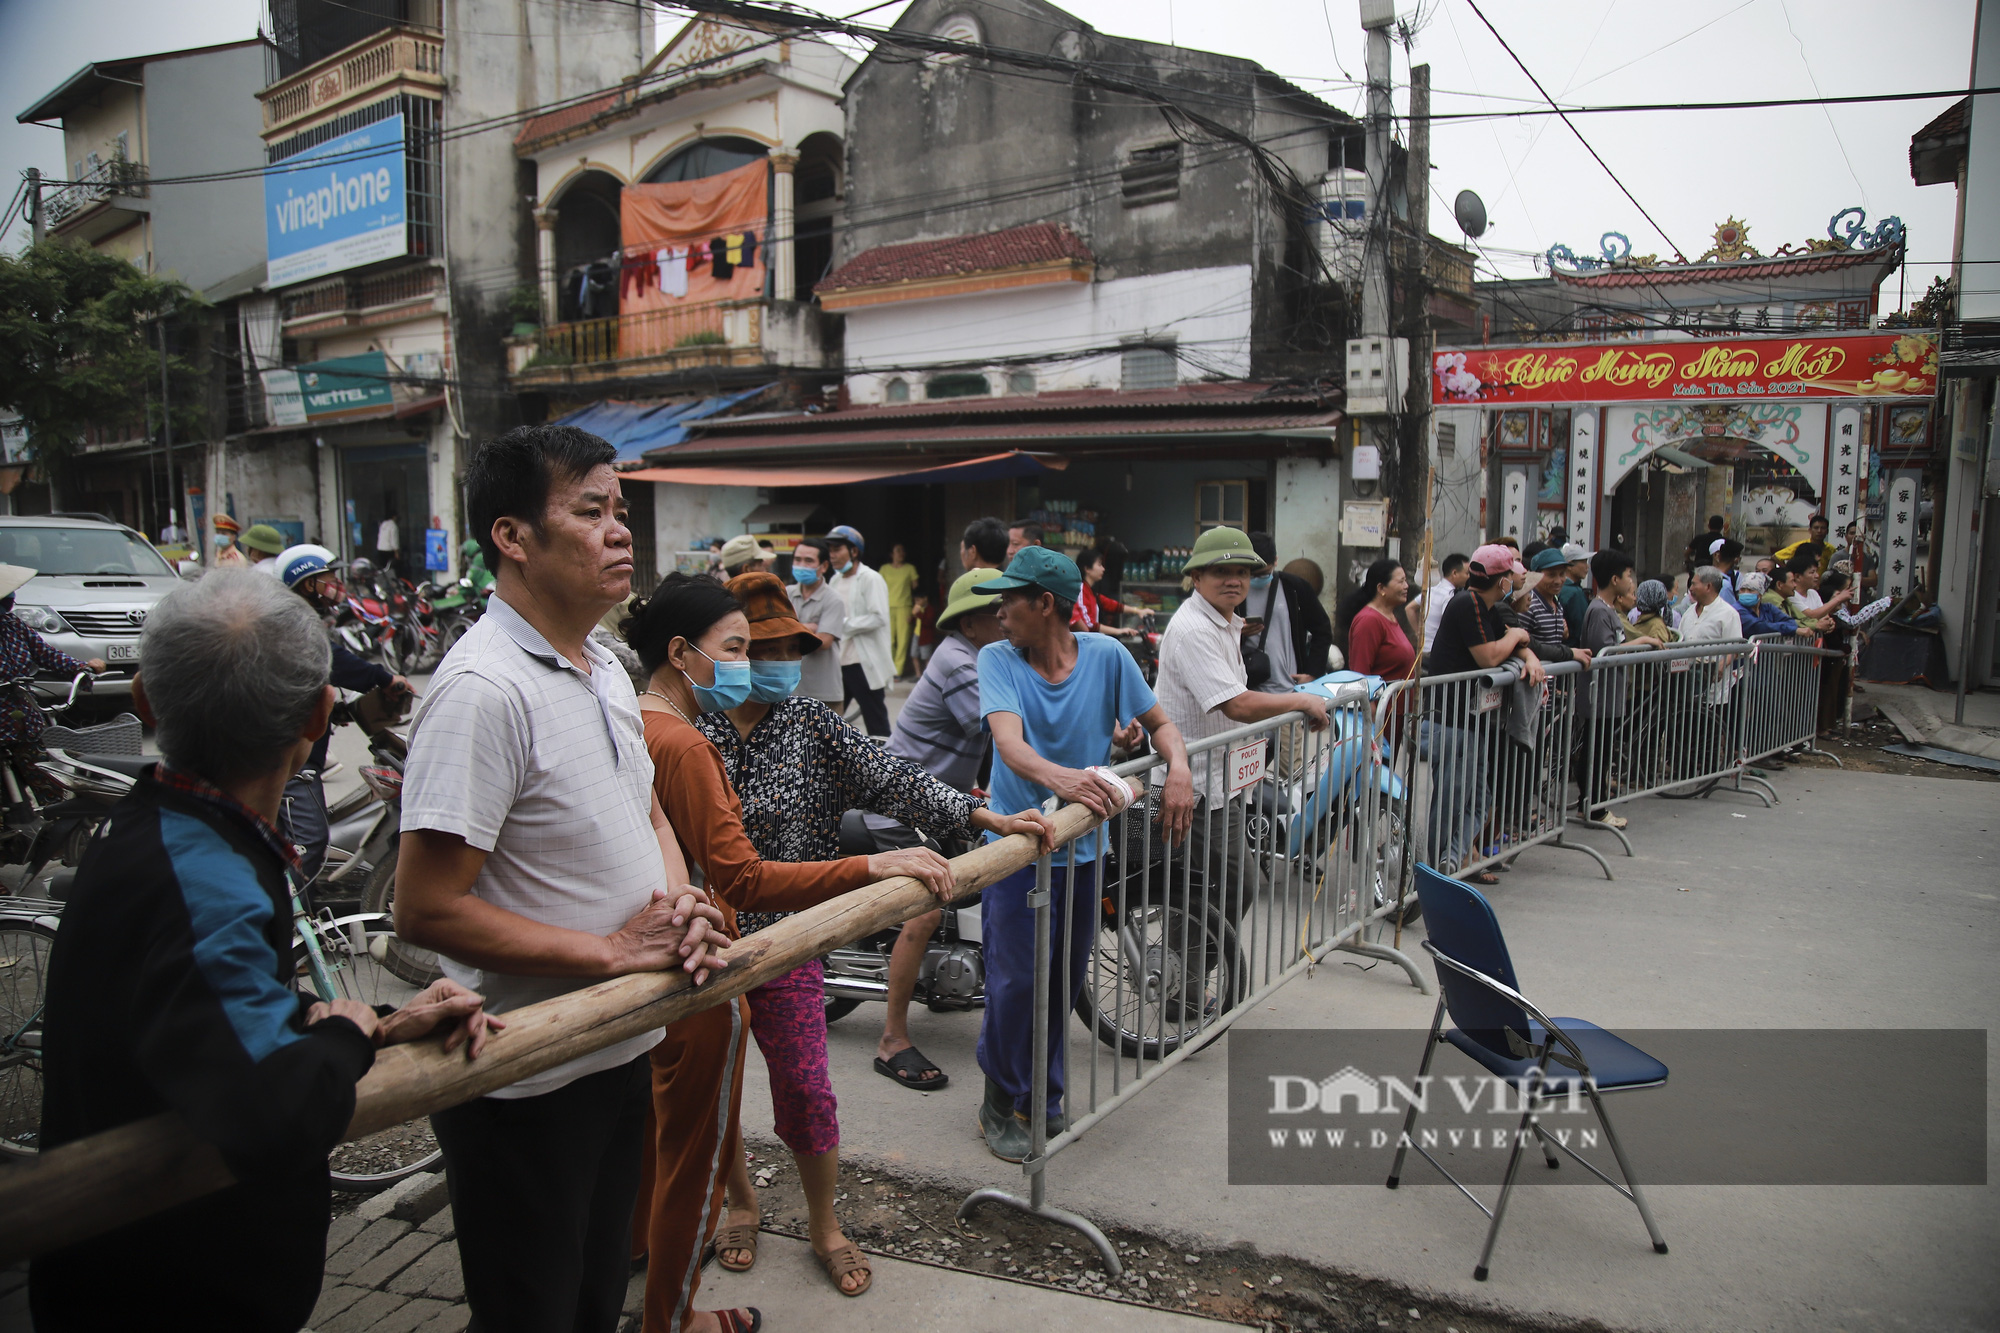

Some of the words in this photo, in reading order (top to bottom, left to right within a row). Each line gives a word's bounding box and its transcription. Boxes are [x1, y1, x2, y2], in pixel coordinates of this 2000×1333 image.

[276, 167, 391, 234] vinaphone
[1505, 353, 1578, 389] Chúc
[1580, 349, 1676, 388] Mừng
[1680, 345, 1759, 379] Năm
[1763, 343, 1846, 381] Mới
[1672, 383, 1706, 396] Xuân
[1707, 382, 1734, 394] Tân
[1737, 381, 1765, 394] Sửu
[1768, 382, 1806, 394] 2021
[308, 388, 368, 406] VIETTEL
[291, 561, 315, 576] TANA
[1485, 692, 1500, 703] STOP
[1241, 748, 1258, 760] POLICE
[1238, 760, 1260, 780] STOP
